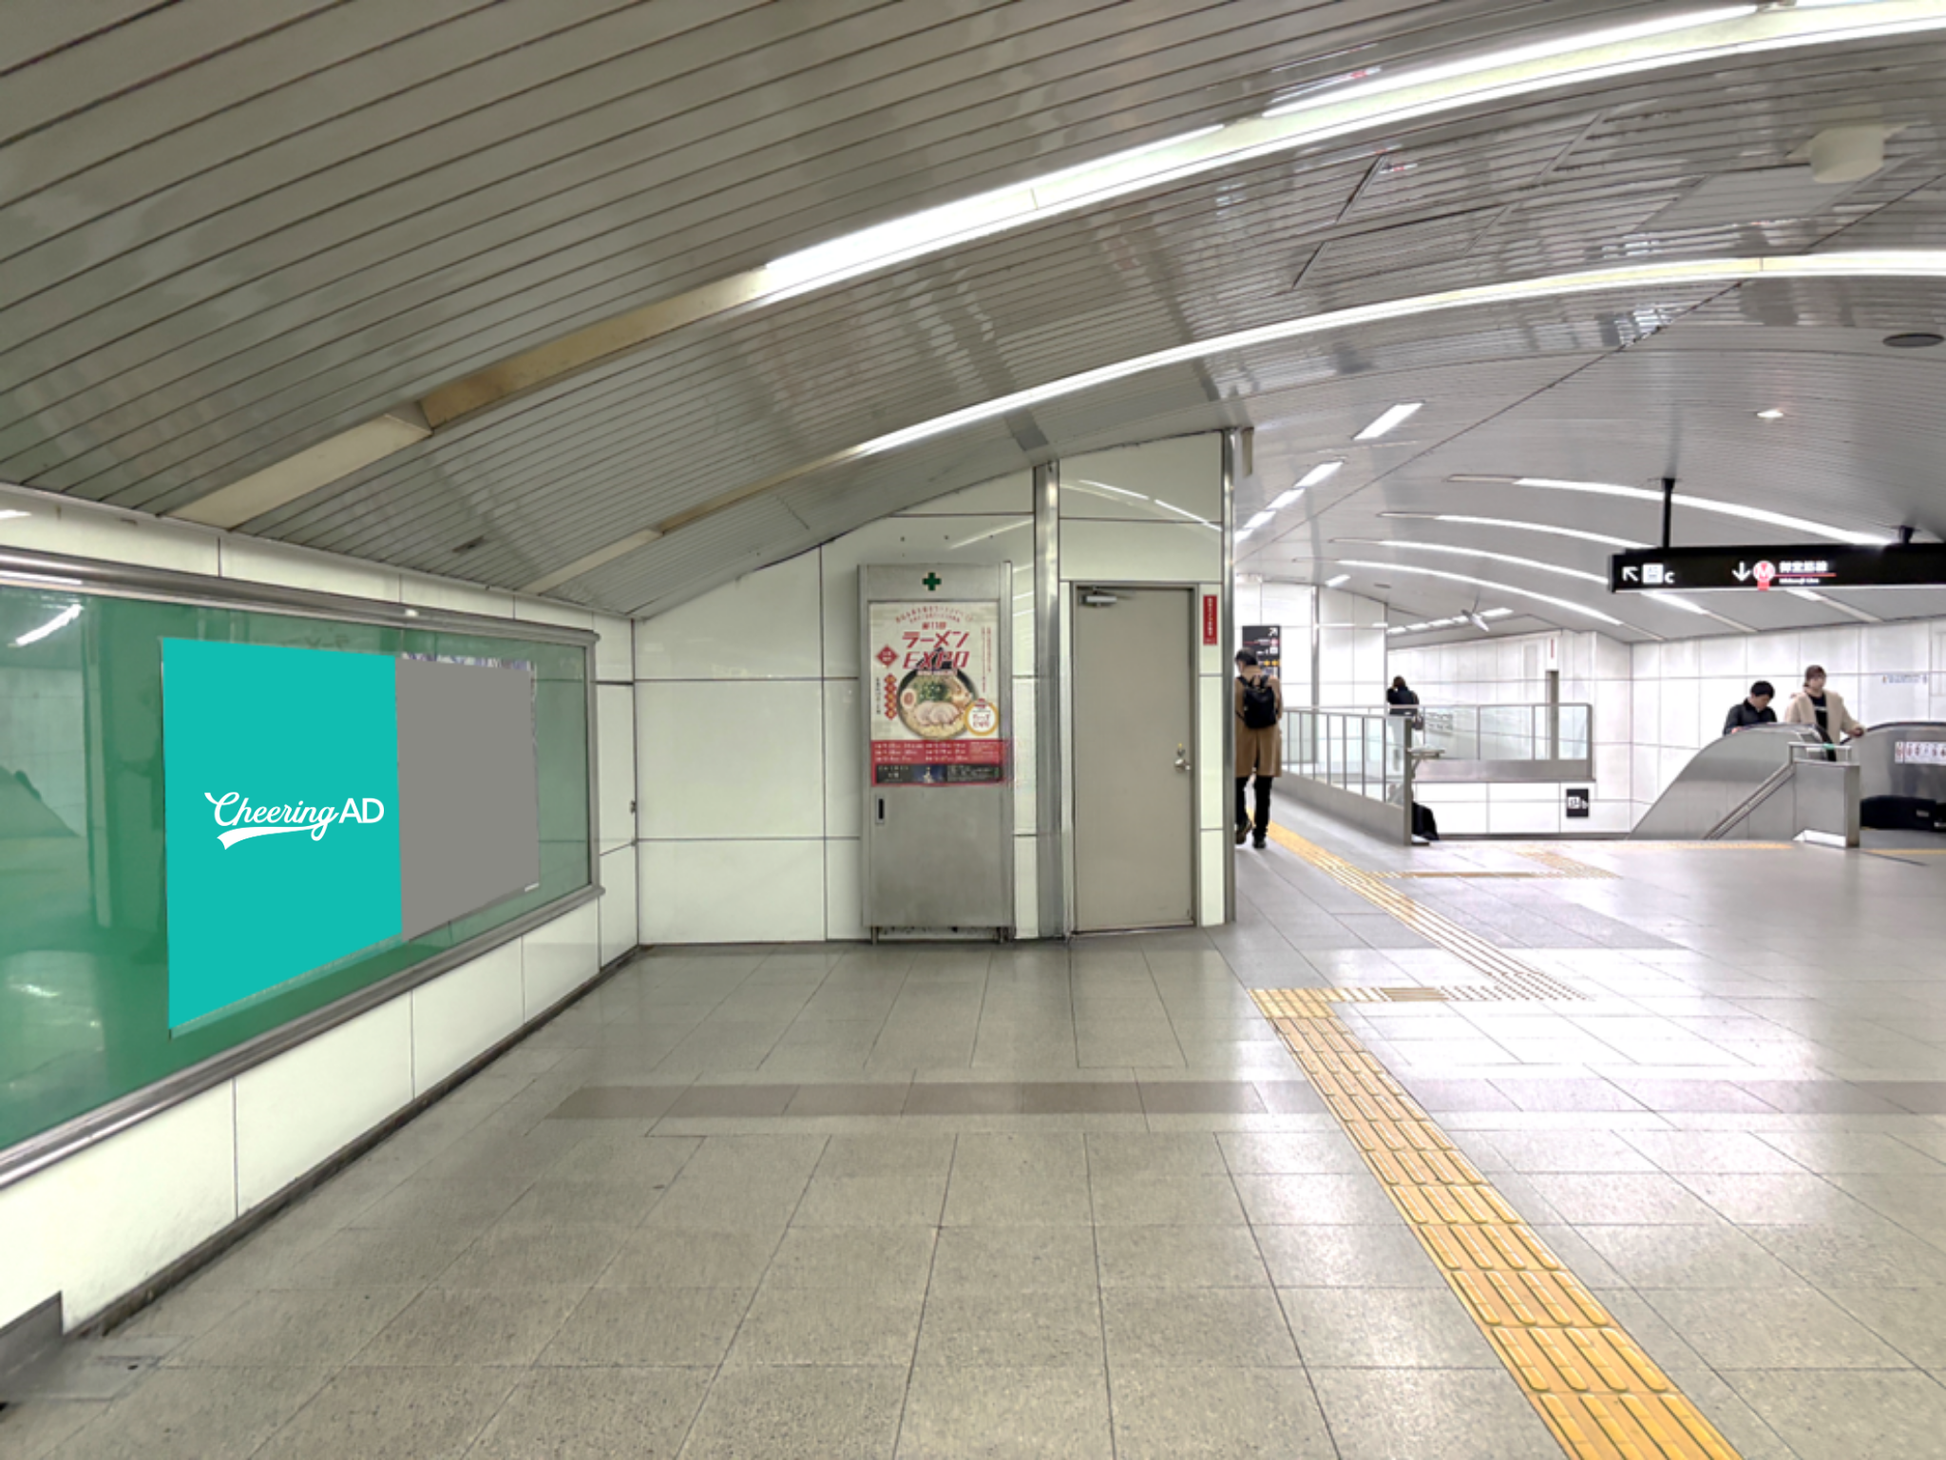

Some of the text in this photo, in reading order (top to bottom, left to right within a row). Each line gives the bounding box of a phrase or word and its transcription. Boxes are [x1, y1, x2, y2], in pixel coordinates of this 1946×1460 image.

[902, 630, 970, 649] ラーメン
[902, 650, 970, 670] EXPO
